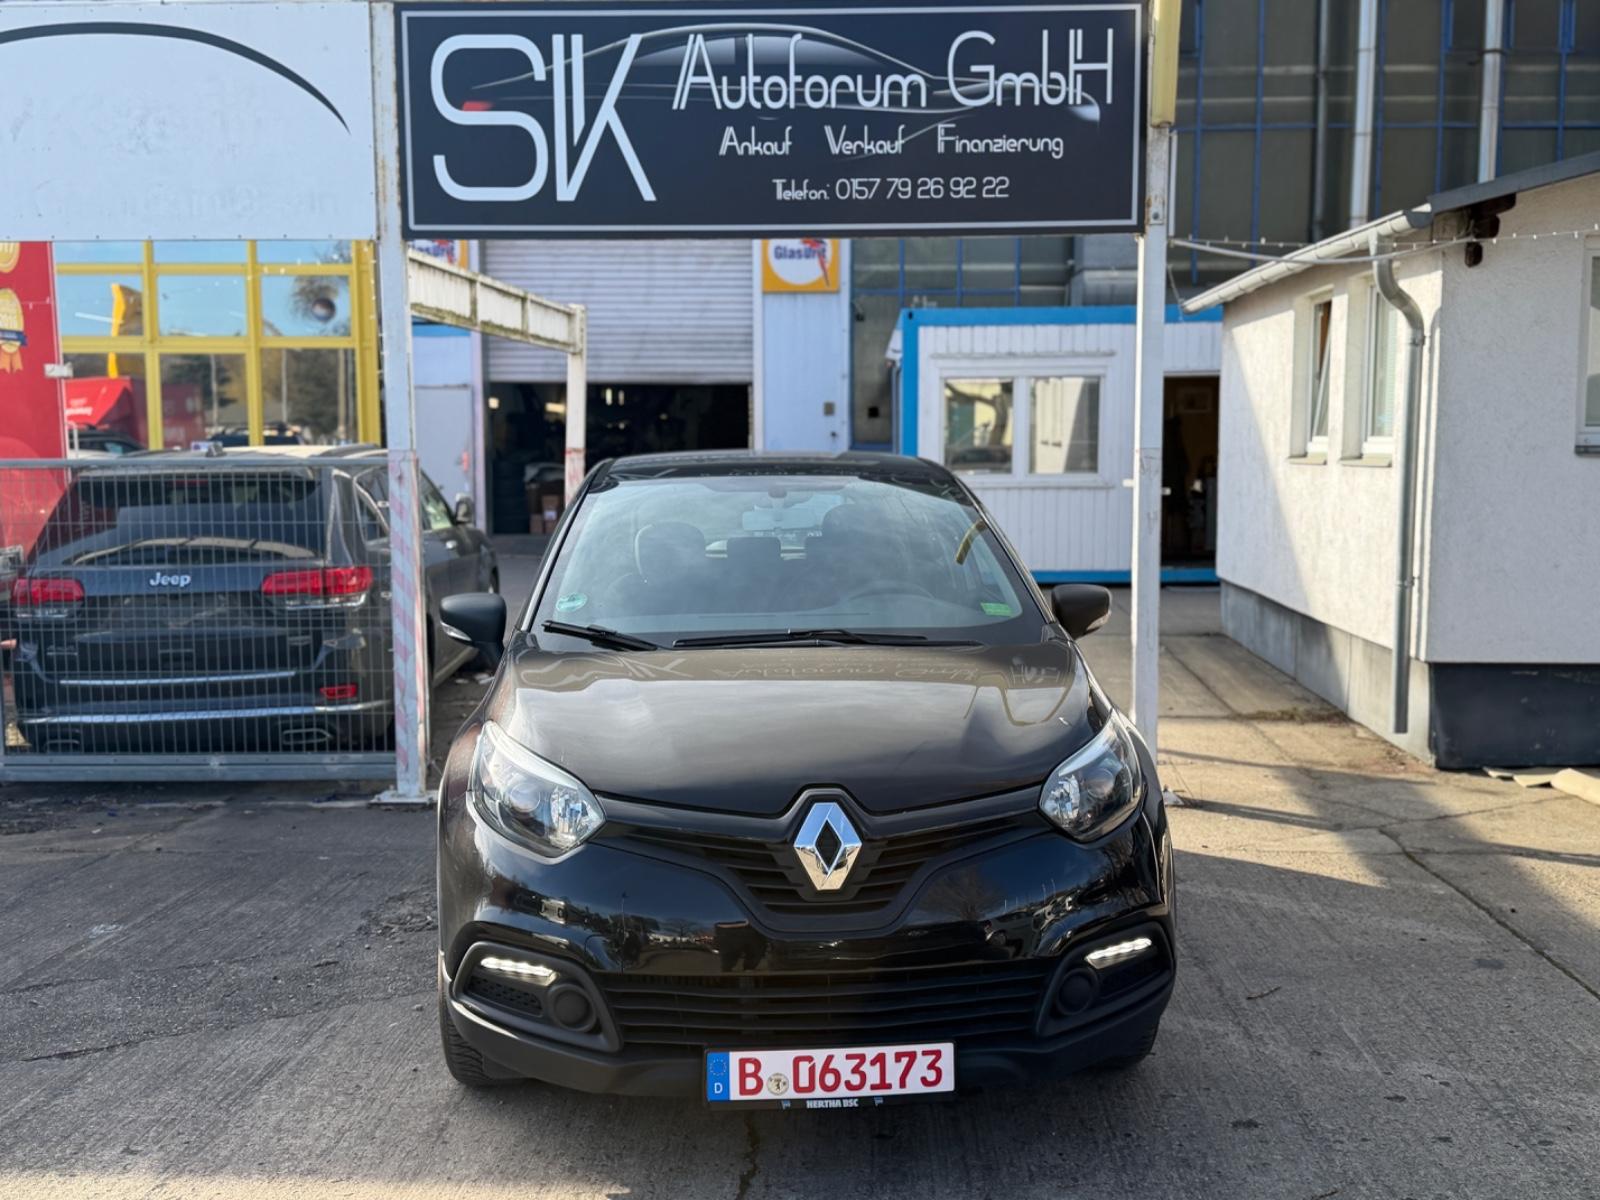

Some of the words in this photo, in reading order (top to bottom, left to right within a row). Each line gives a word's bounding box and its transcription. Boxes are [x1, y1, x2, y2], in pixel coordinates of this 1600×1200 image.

[431, 34, 657, 201] SK
[672, 33, 927, 110] Autoforum
[947, 28, 1113, 107] GmbH
[719, 126, 793, 156] Ankauf
[824, 125, 905, 155] Verkauf
[937, 124, 1064, 159] Finanzierung
[772, 178, 830, 201] Telefon:
[835, 178, 881, 200] 0157
[886, 178, 912, 199] 79
[917, 178, 944, 199] 26
[950, 177, 976, 198] 92
[982, 177, 1010, 198] 22
[149, 571, 192, 588] Jeep
[738, 1057, 764, 1096] B
[792, 1049, 943, 1093] 063173
[714, 1082, 723, 1094] D
[806, 1099, 841, 1109] HERTHA
[843, 1098, 859, 1108] BSC
